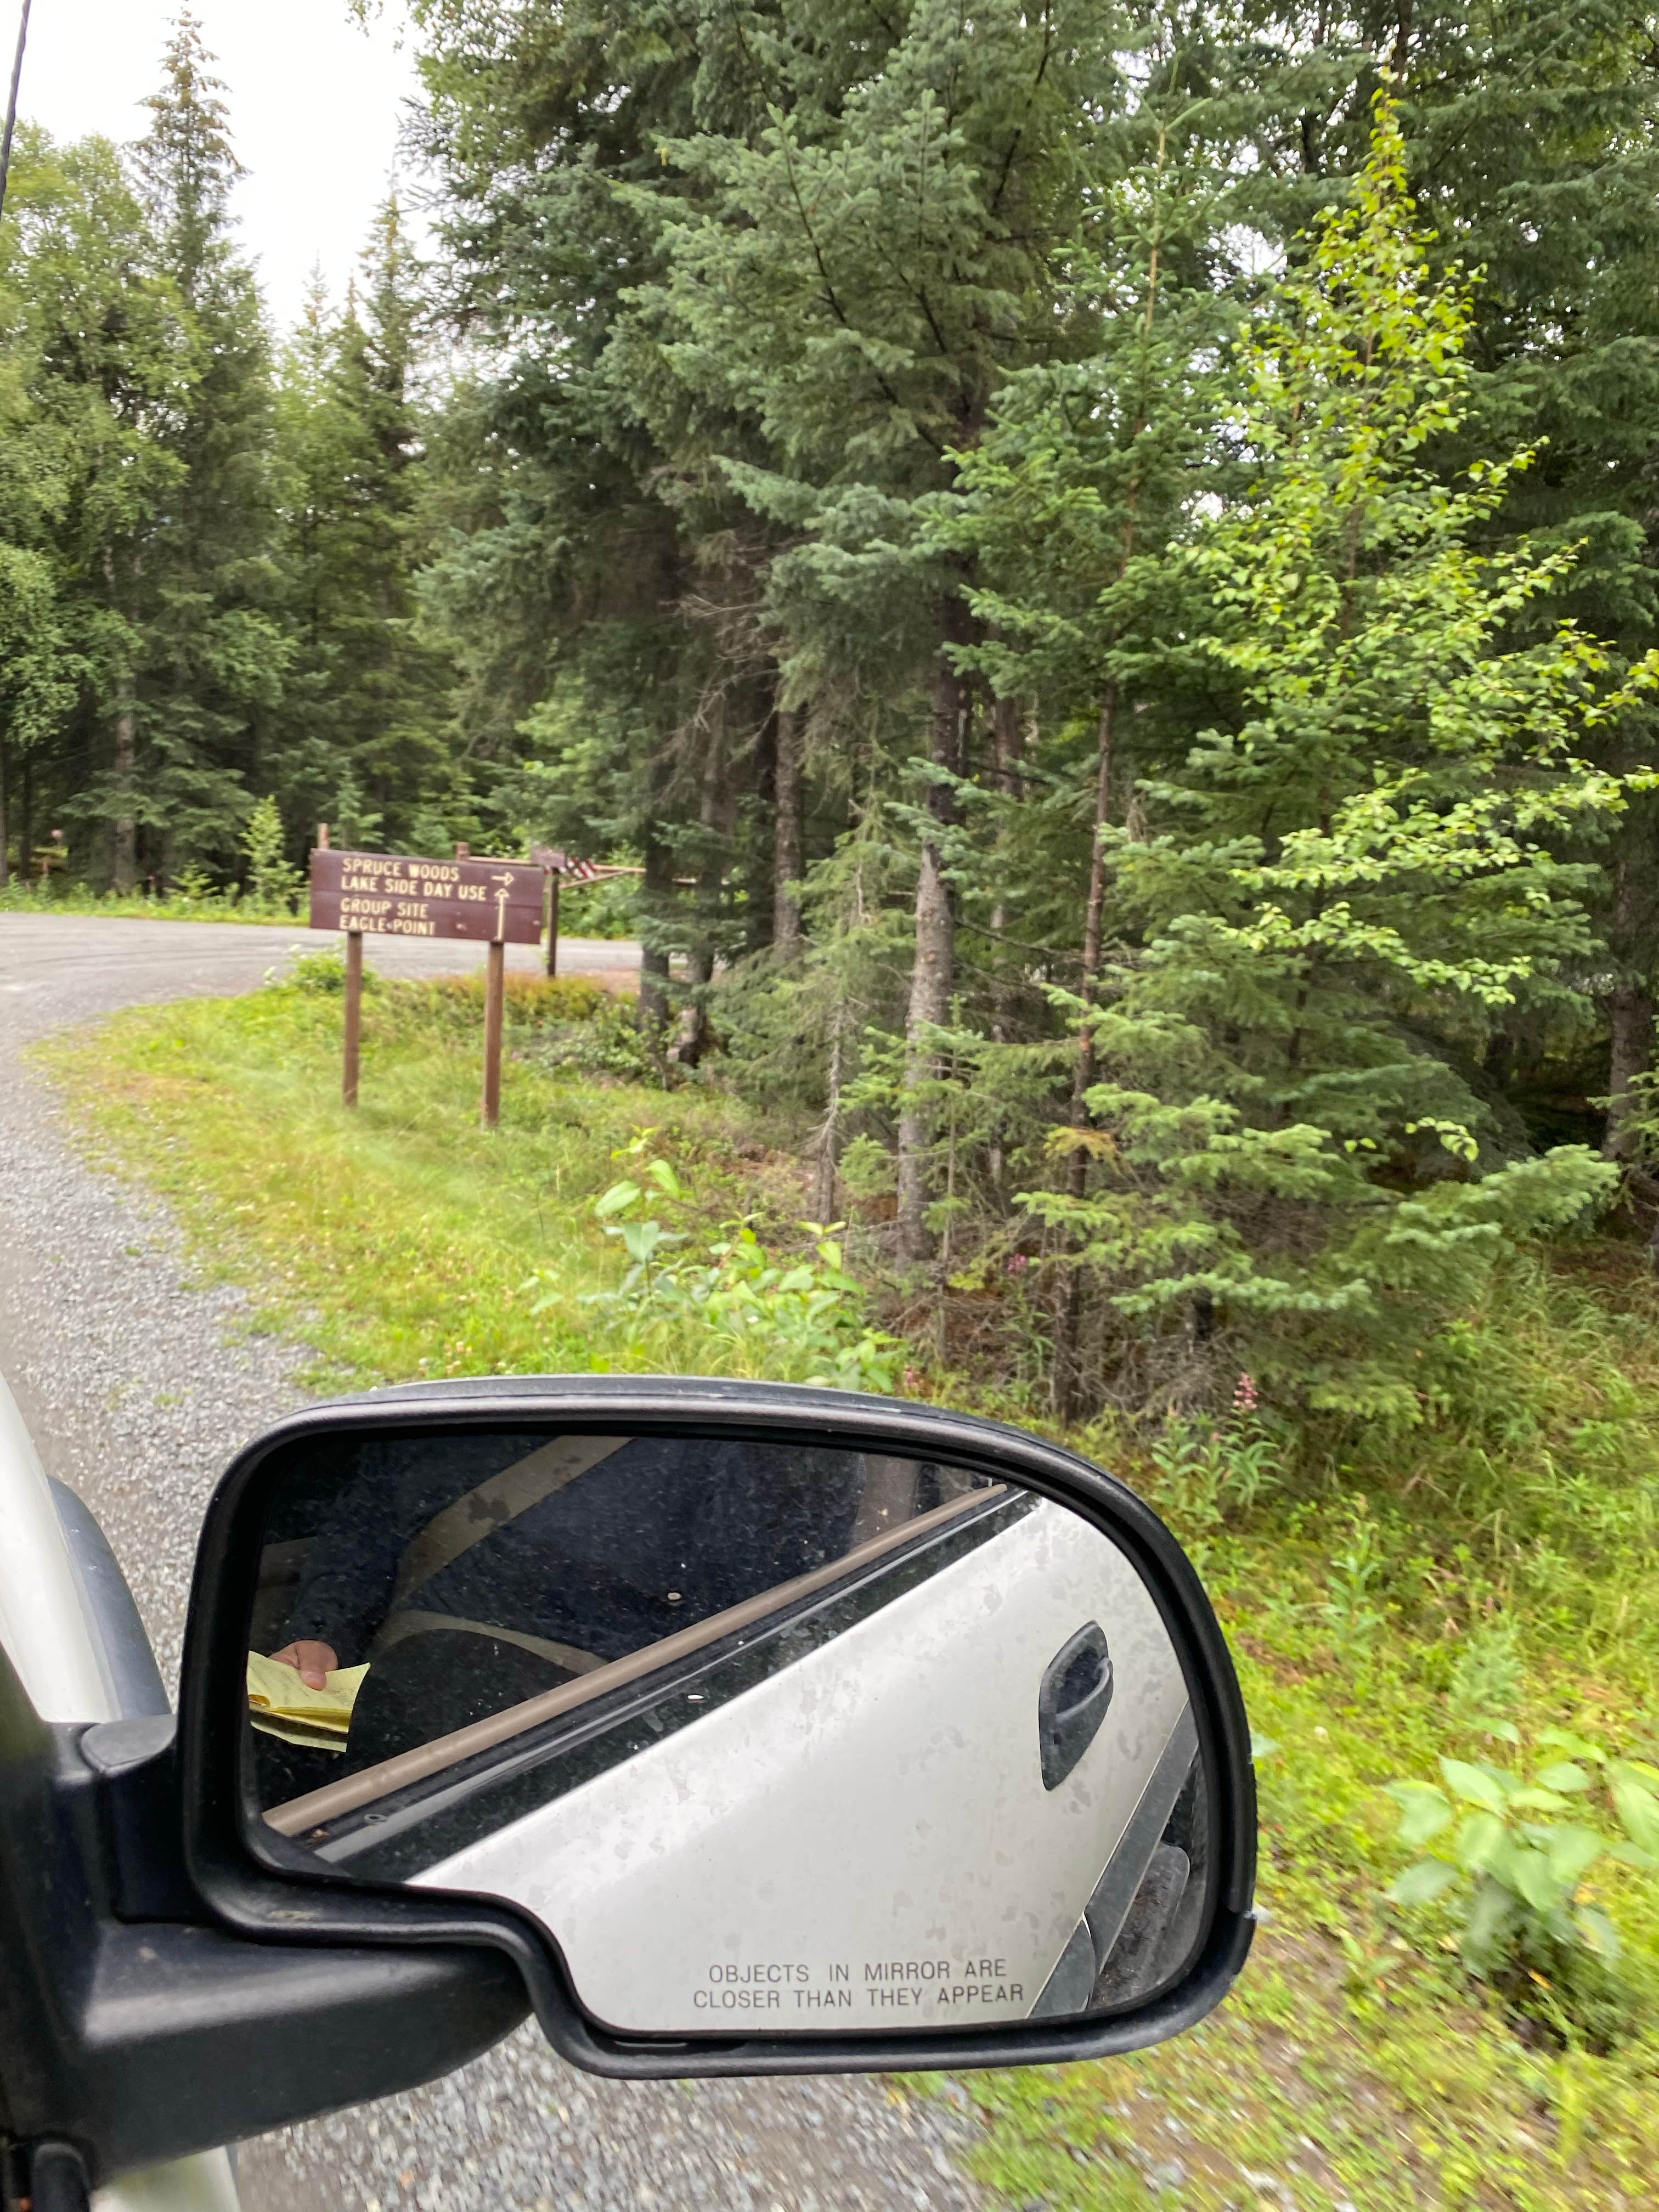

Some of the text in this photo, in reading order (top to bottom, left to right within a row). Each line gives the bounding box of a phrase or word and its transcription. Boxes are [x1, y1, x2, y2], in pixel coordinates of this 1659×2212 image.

[342, 857, 460, 882] SPRUCE WOODS
[341, 875, 487, 901] LAKE SIDE DAY USE
[340, 897, 429, 919] GROUP SITE
[339, 914, 436, 936] EAGLE POINT
[709, 1959, 1007, 1983] OBJECTS IN MIRROR ARE
[693, 1983, 1024, 2008] CLOSER THAN THEY APPEAR
